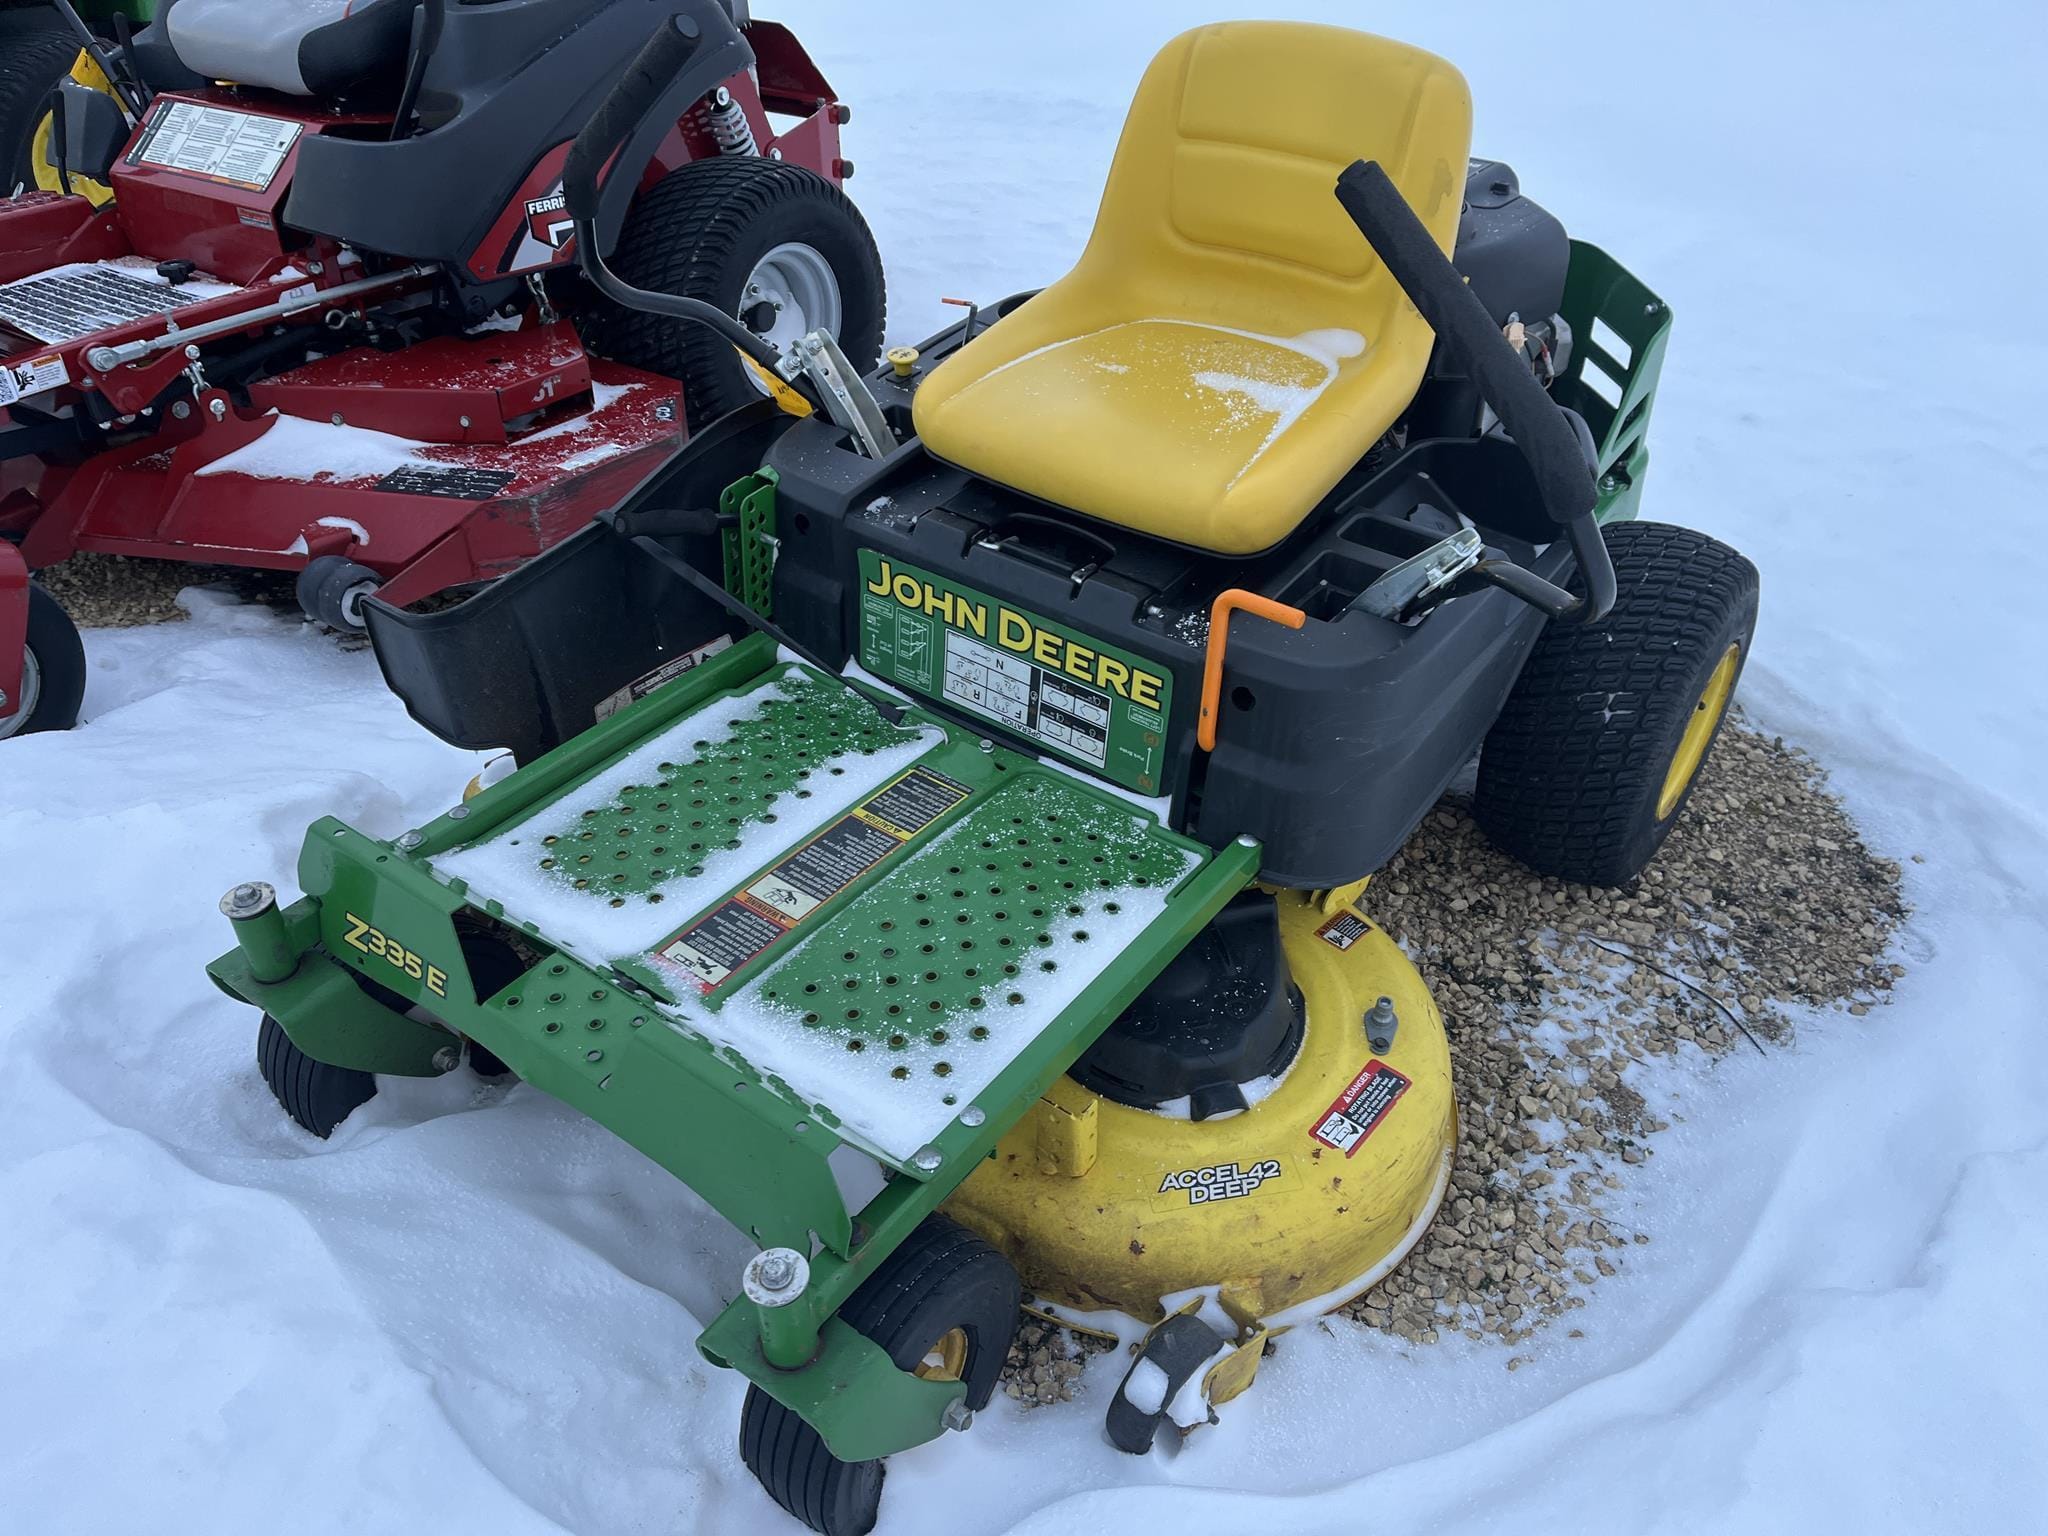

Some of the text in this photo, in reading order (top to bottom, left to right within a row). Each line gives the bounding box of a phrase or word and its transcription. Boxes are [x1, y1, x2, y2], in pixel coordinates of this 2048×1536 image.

[866, 560, 1164, 711] JOHN DEERE
[996, 658, 1003, 670] N
[973, 689, 980, 700] R
[1014, 708, 1021, 719] F
[1001, 716, 1041, 739] OPERATION
[862, 813, 894, 830] CAUTION
[743, 895, 780, 919] WARNING
[343, 911, 449, 999] Z335 E
[1346, 1071, 1372, 1097] DANGER
[1347, 1090, 1370, 1113] ROTATING
[1189, 1177, 1261, 1205] DEEP
